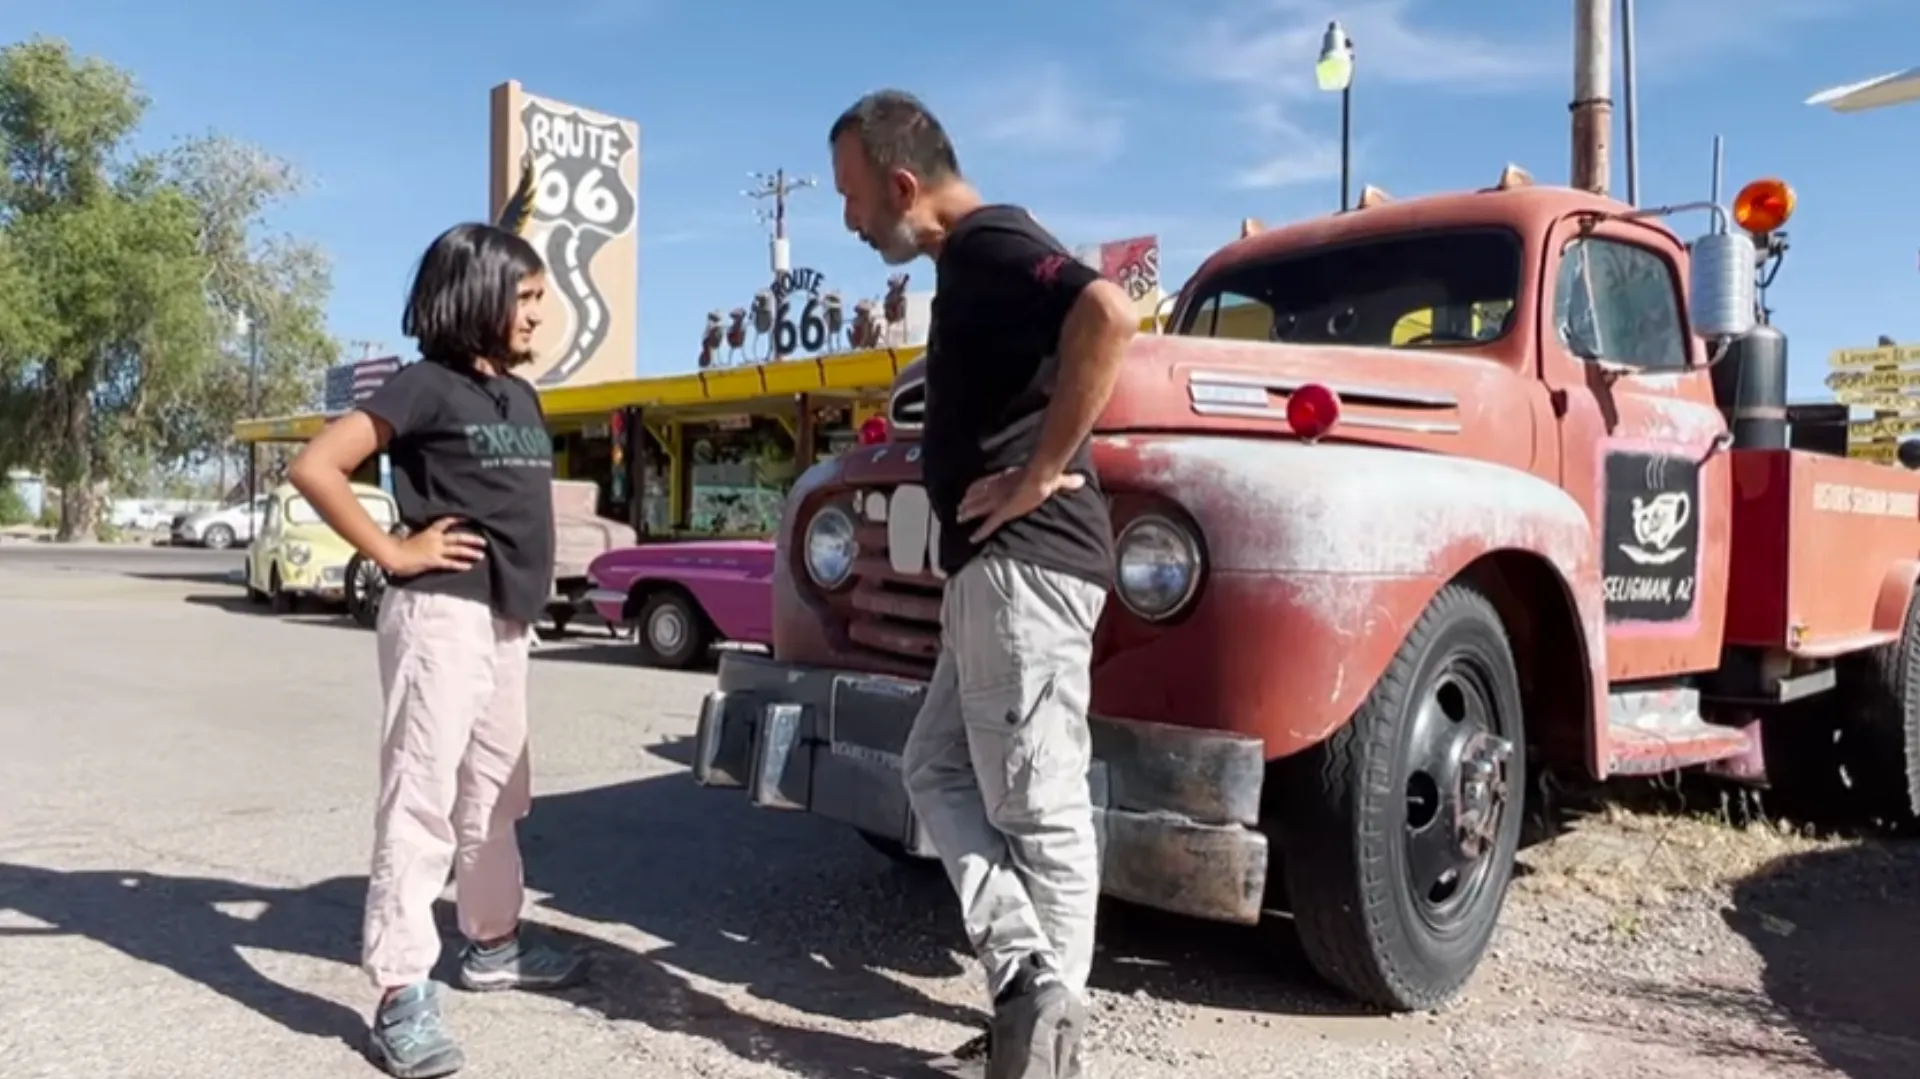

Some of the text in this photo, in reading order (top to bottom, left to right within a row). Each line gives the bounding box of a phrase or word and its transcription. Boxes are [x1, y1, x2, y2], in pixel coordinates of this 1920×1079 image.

[531, 112, 620, 168] ROUTE
[533, 152, 619, 223] 66
[771, 267, 824, 297] ROUTE
[774, 298, 824, 354] 66
[1674, 576, 1694, 601] AZ
